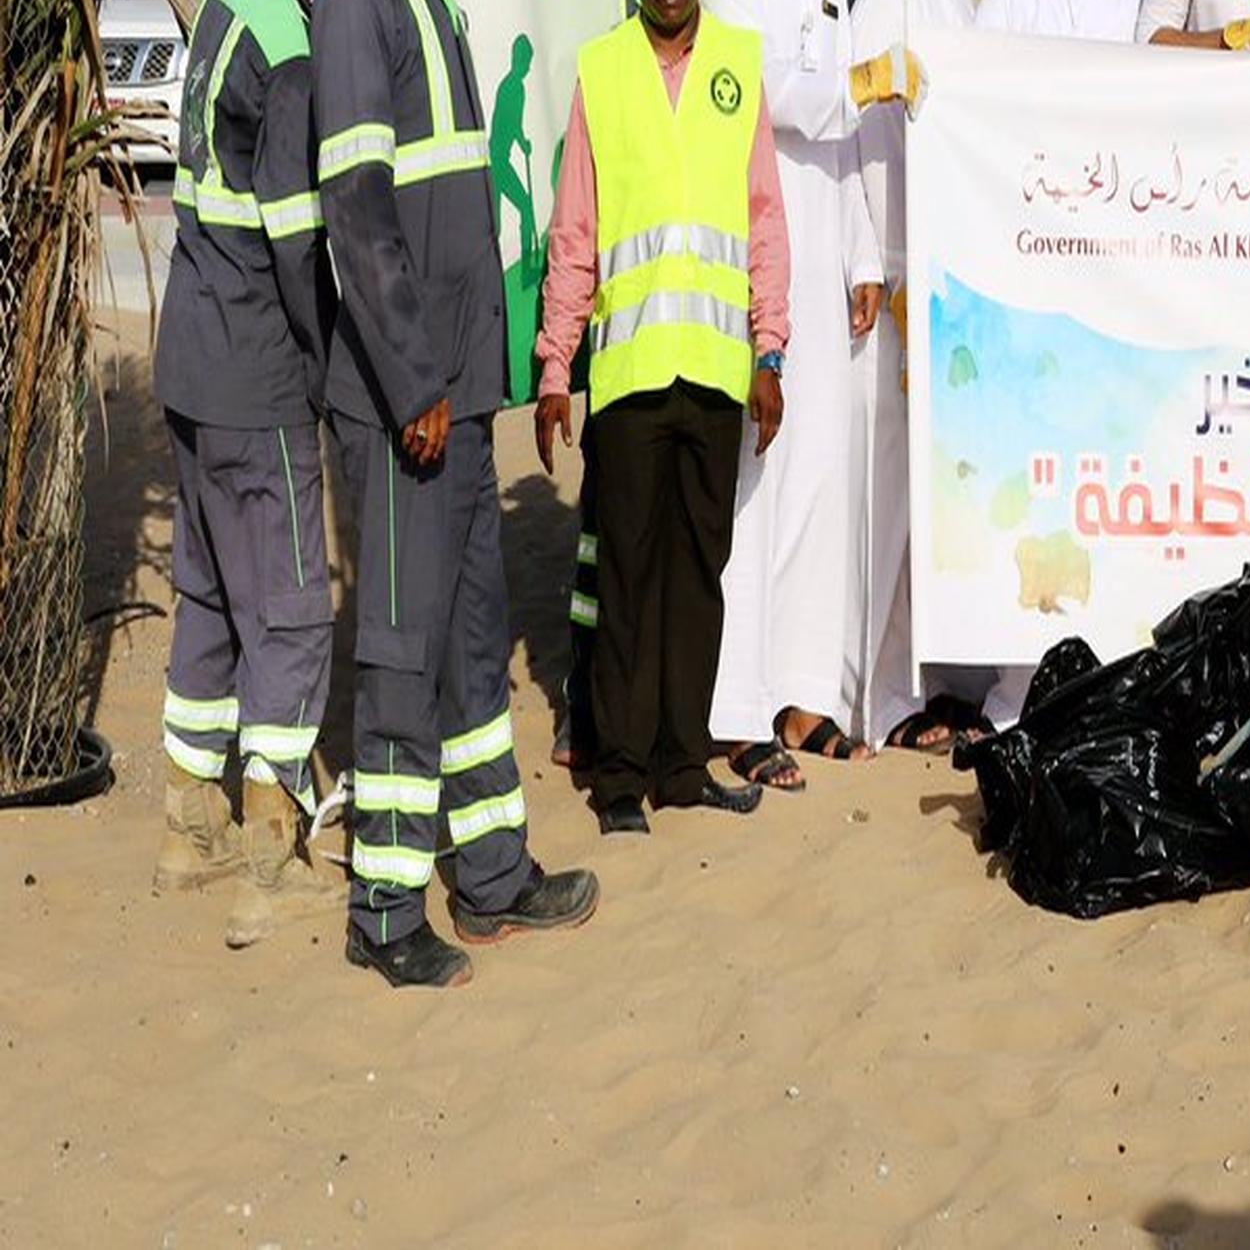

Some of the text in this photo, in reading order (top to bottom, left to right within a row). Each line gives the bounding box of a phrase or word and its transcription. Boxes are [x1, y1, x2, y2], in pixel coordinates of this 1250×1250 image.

[1016, 228, 1138, 258] Government
[1143, 230, 1164, 259] of
[1170, 233, 1202, 259] Ras
[1208, 232, 1228, 259] Al
